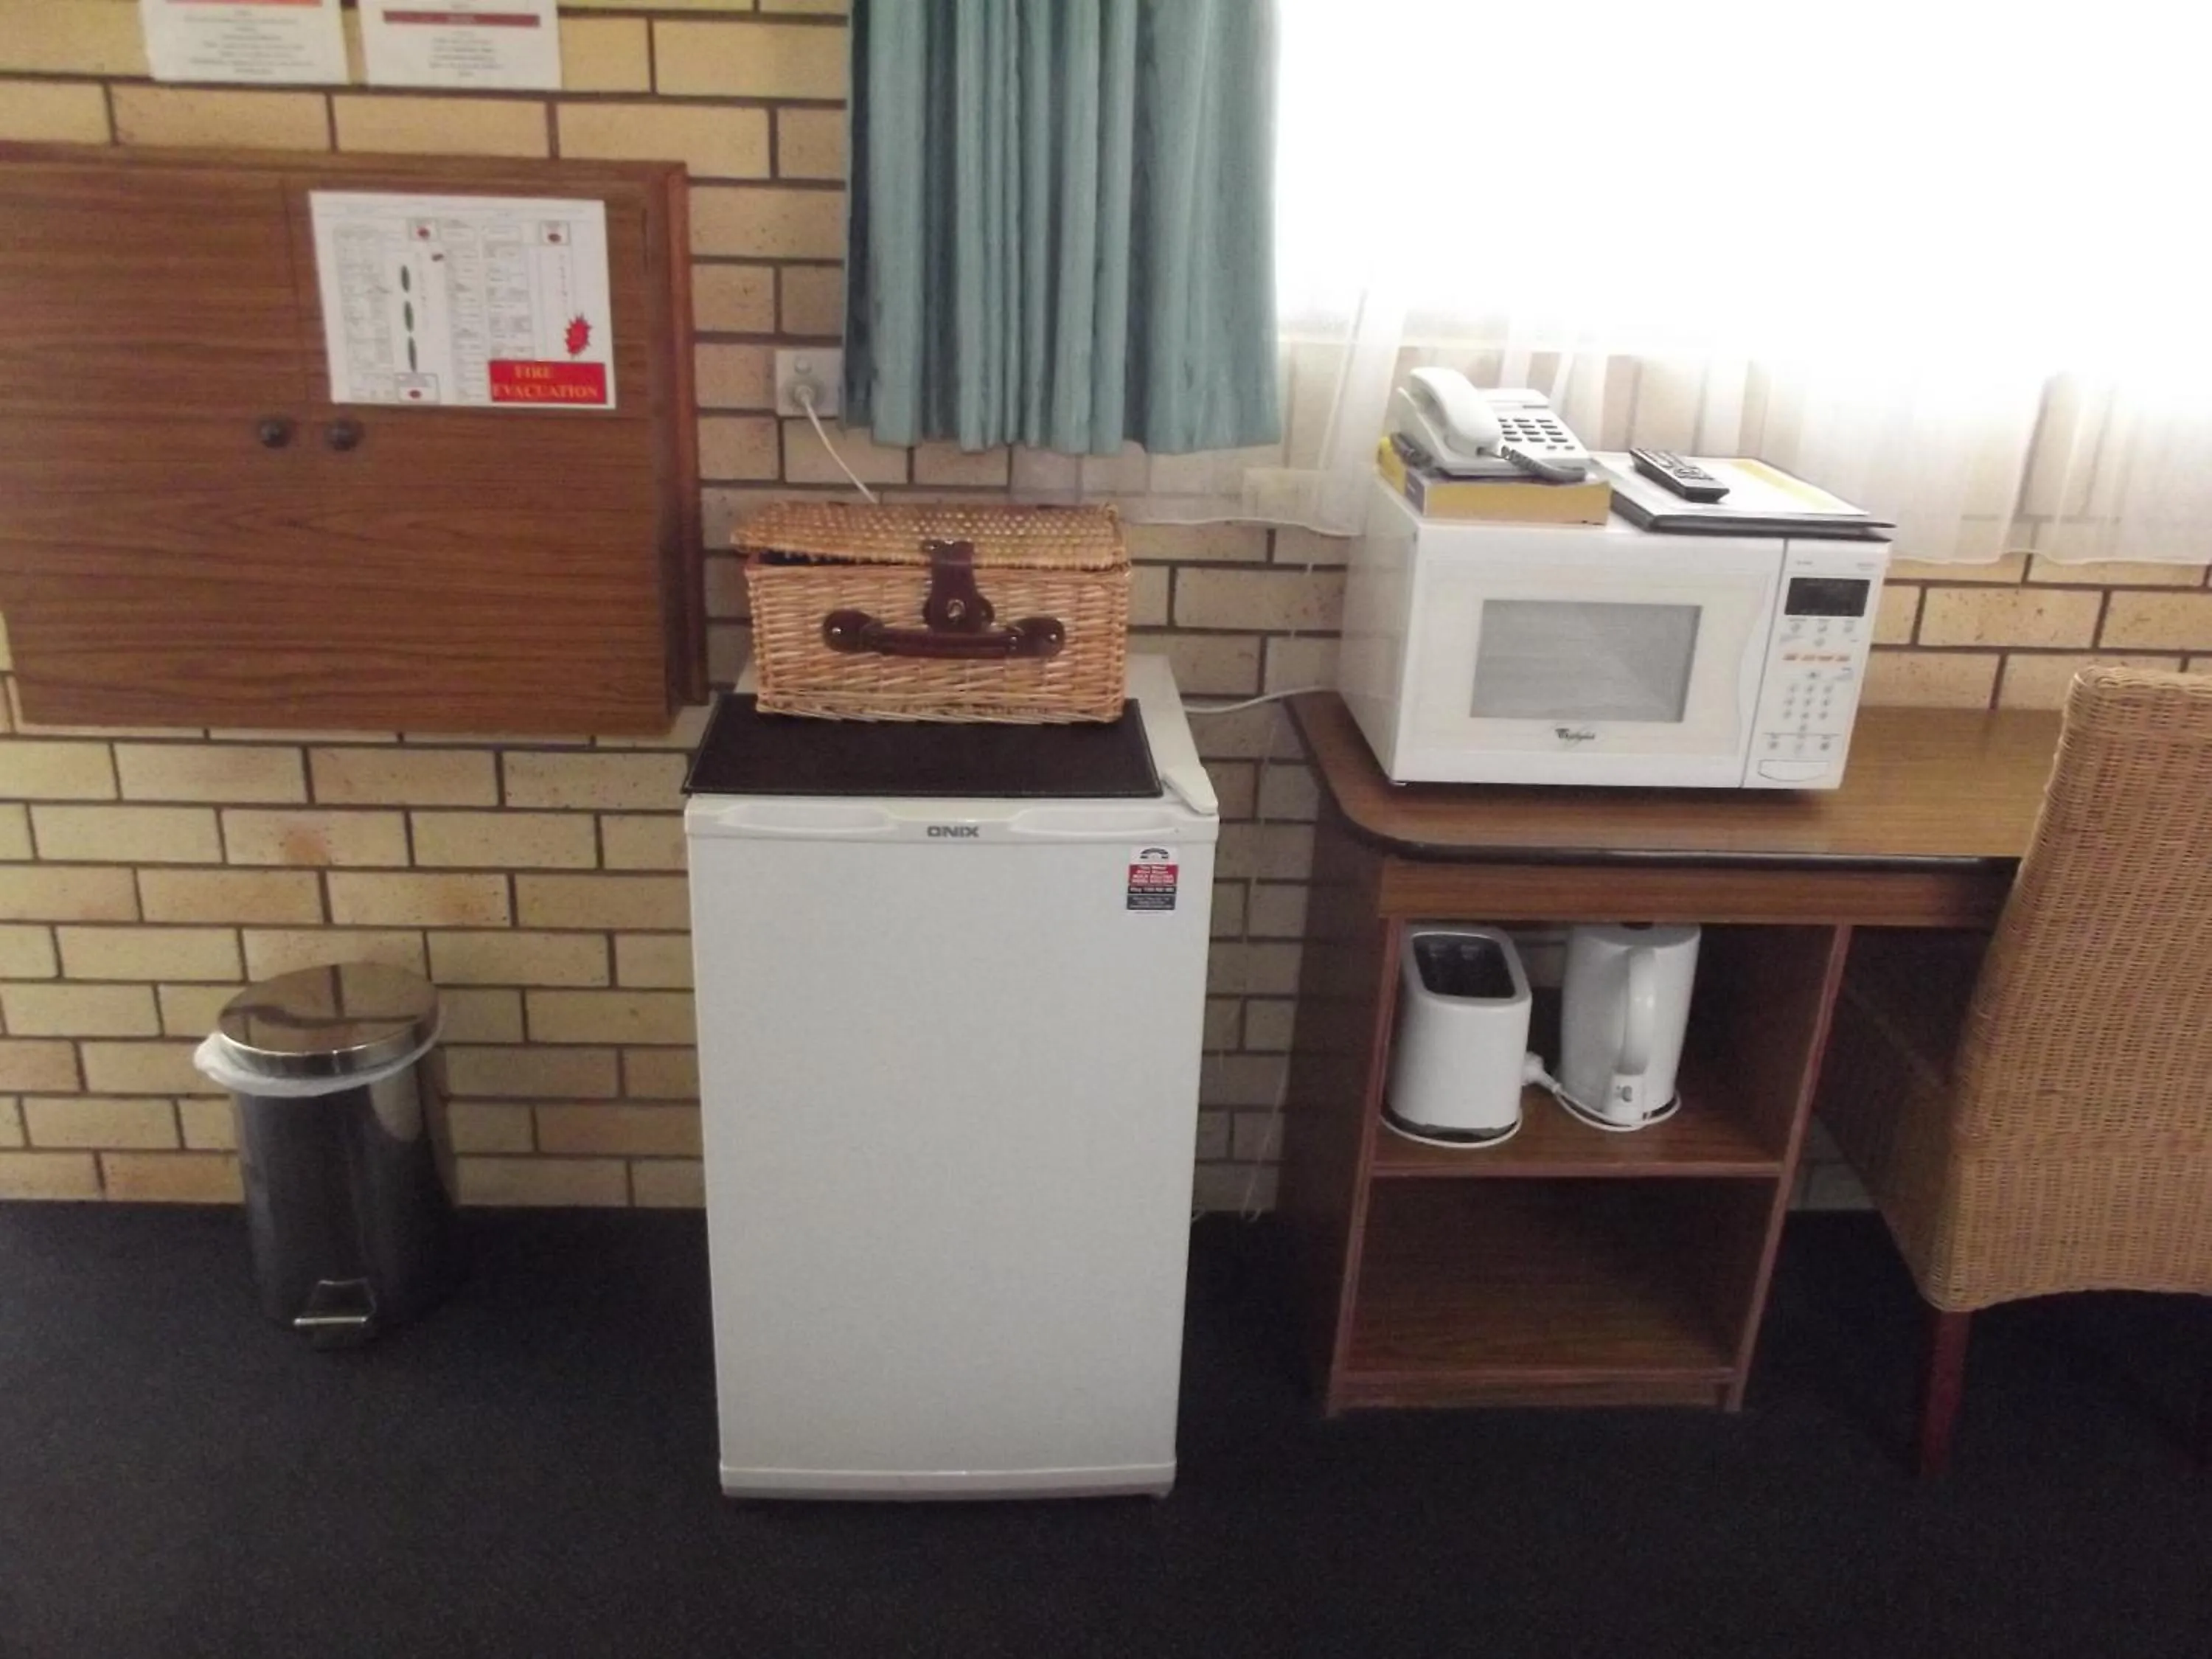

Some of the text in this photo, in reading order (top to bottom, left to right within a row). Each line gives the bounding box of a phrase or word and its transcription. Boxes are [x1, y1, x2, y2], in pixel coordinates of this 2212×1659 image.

[515, 364, 551, 378] FIRE
[493, 383, 598, 398] EVACUATION
[927, 825, 980, 838] ONIX
